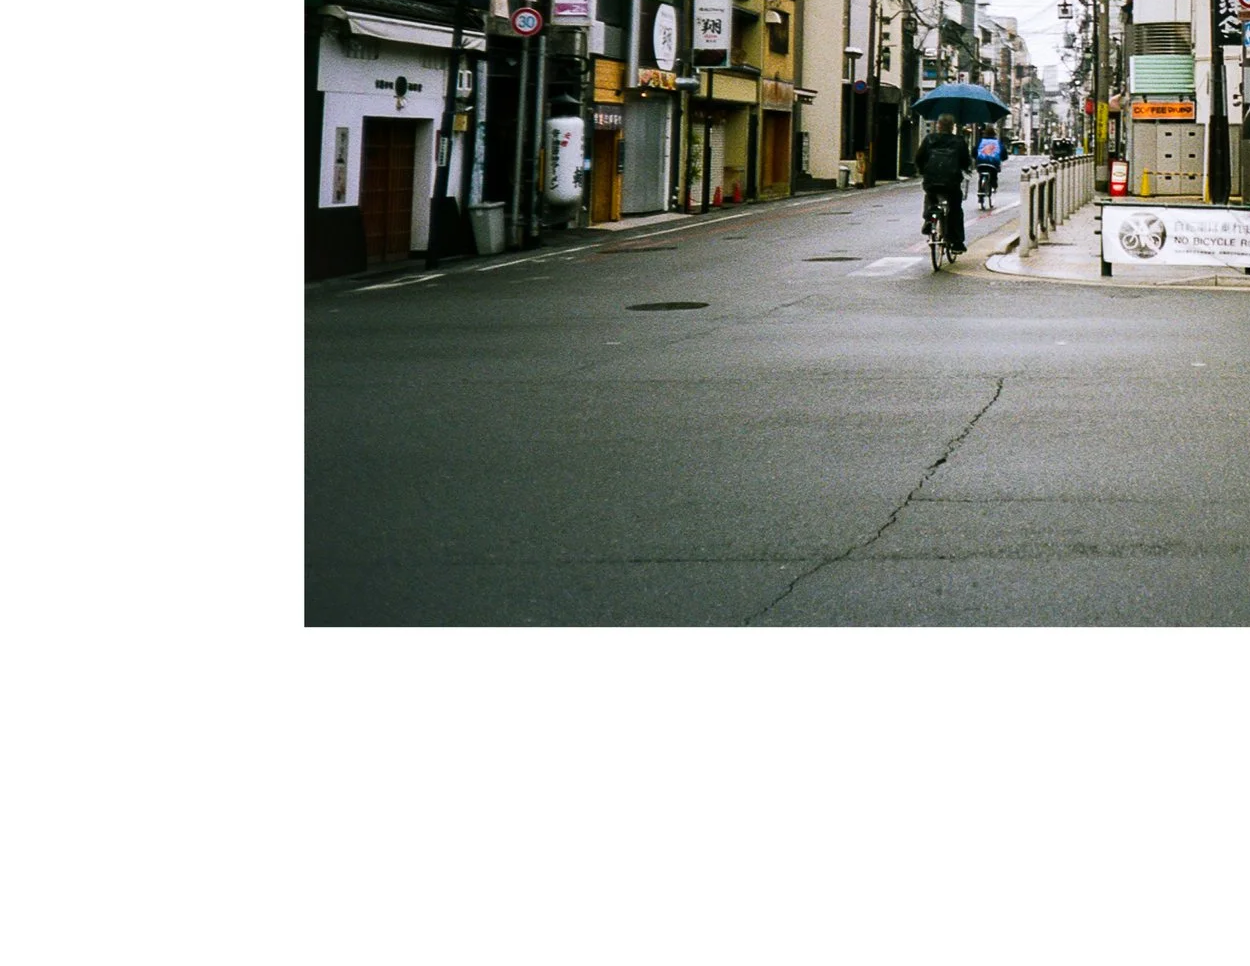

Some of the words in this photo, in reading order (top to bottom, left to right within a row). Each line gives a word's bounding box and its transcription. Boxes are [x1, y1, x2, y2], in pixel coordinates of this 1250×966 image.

[519, 16, 535, 28] 30
[1174, 236, 1188, 245] NO
[1193, 237, 1236, 247] BICYCLE
